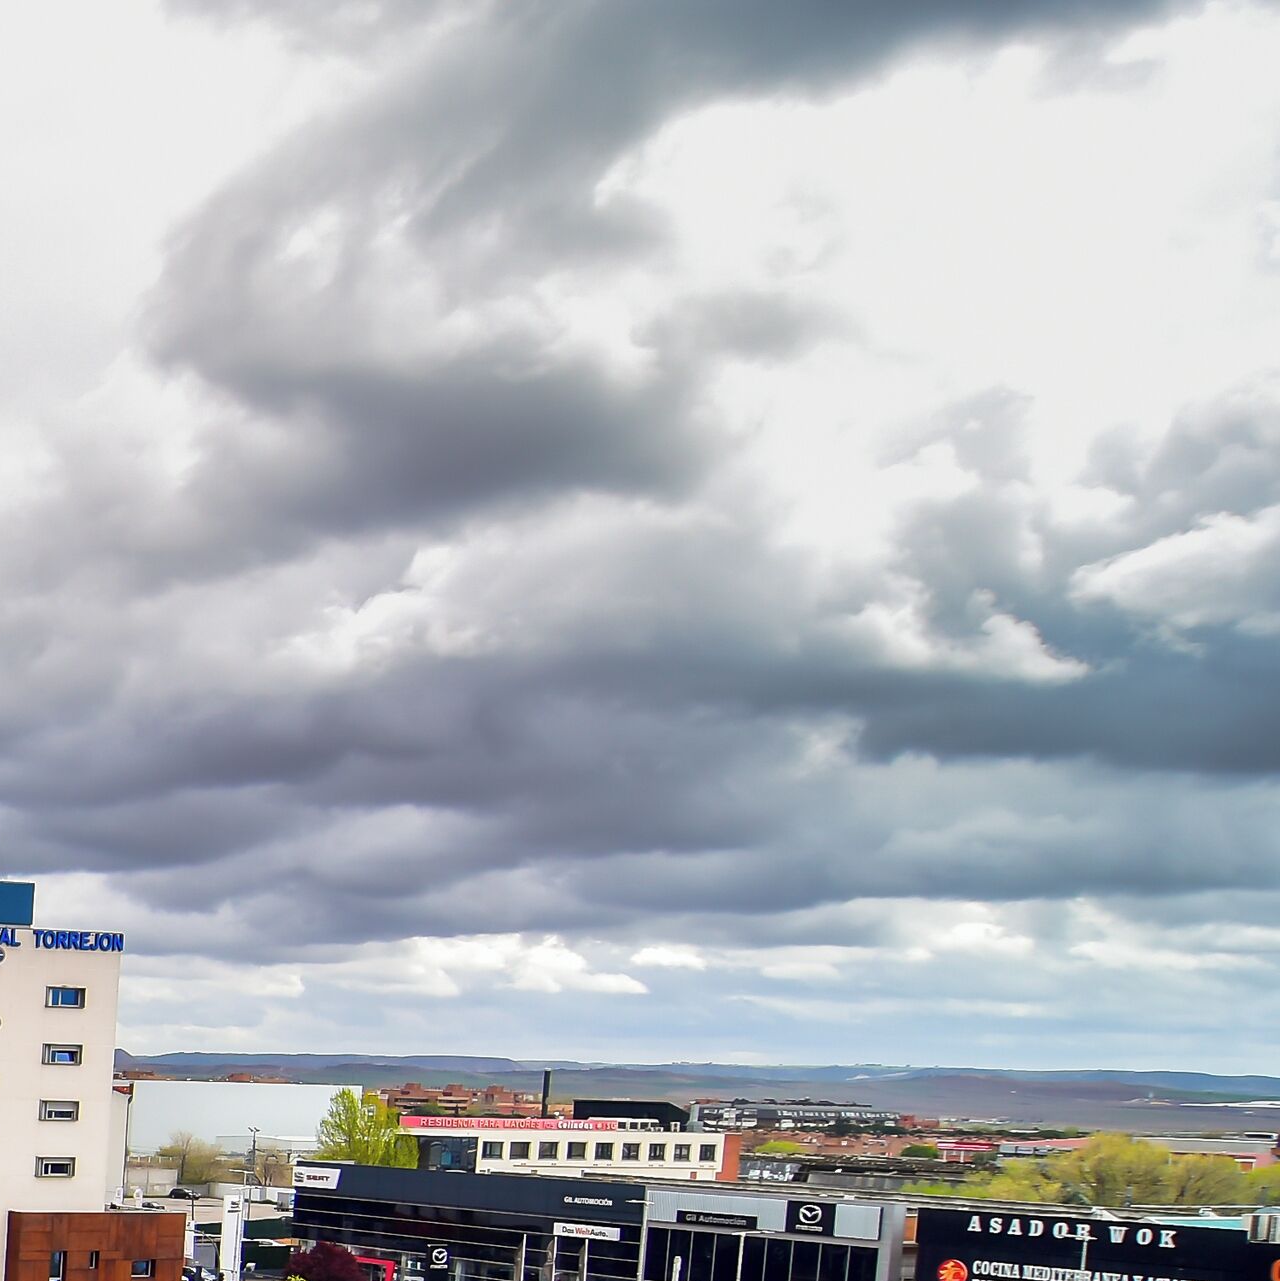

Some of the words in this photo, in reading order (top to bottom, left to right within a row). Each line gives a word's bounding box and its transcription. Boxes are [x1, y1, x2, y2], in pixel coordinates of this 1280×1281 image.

[33, 929, 124, 952] TORREJON
[419, 1117, 476, 1128] RESIDENCIA
[479, 1118, 500, 1128] PARA
[503, 1119, 541, 1129] MAYORES
[306, 1174, 331, 1182] SEAT
[562, 1226, 574, 1234] Das
[967, 1215, 1092, 1240] ASADOR
[1108, 1226, 1177, 1248] WOK
[972, 1260, 1020, 1279] COCINA
